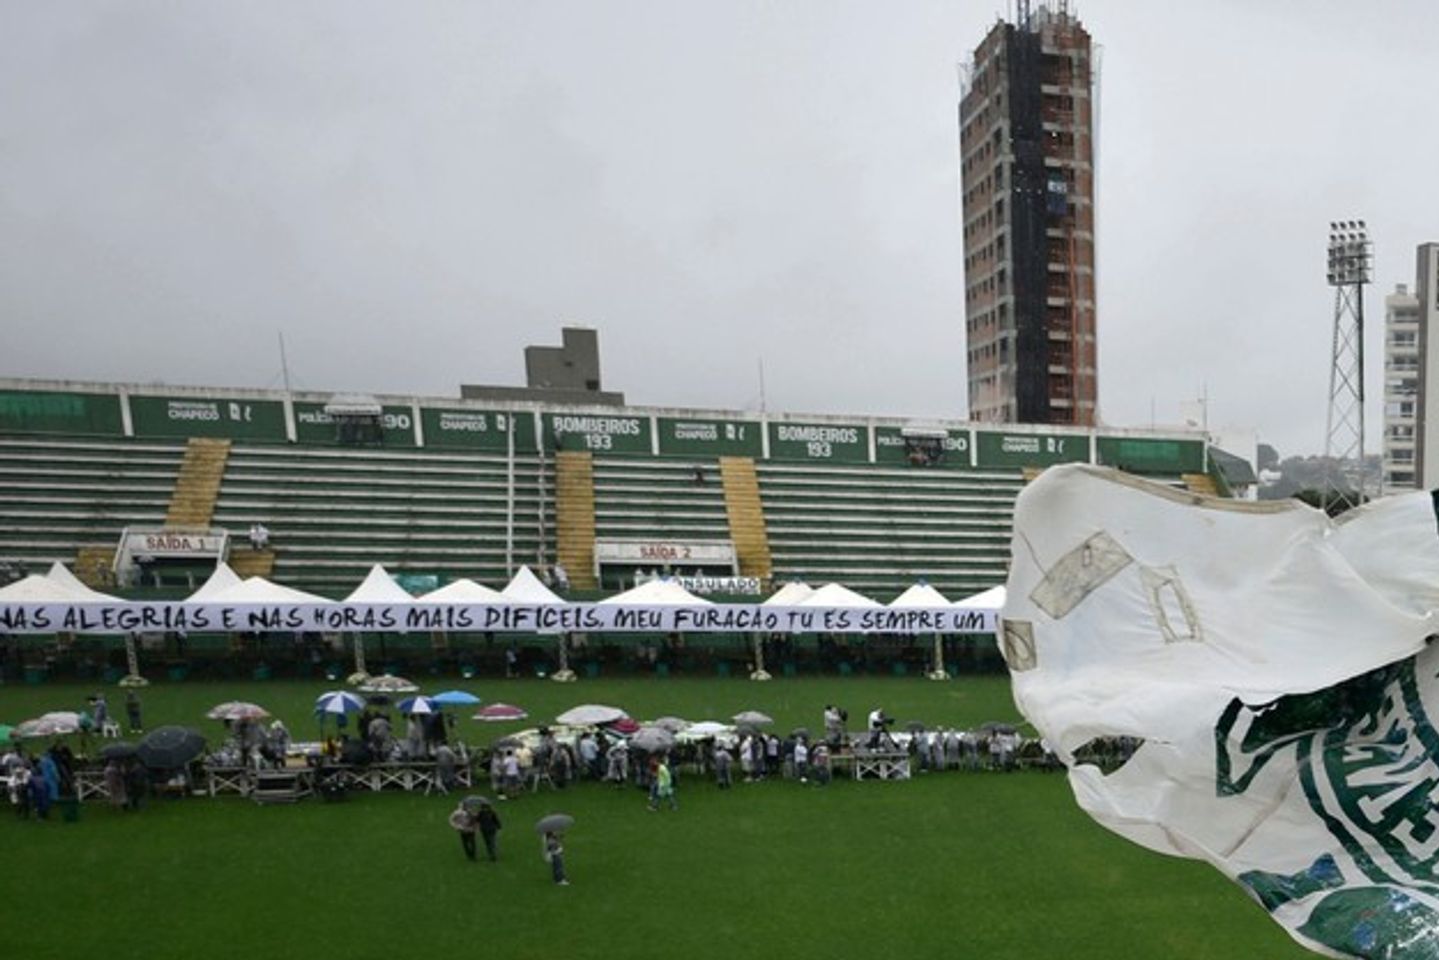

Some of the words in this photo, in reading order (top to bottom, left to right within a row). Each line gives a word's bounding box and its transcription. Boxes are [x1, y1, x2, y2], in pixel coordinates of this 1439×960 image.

[553, 416, 640, 435] BOMBEIROS
[585, 435, 612, 449] 193
[778, 426, 857, 443] BOMBEIROS
[807, 443, 832, 457] 193
[147, 534, 191, 550] SAÍDA
[199, 538, 205, 550] 1
[640, 544, 677, 559] SAÍDA
[683, 548, 691, 558] 2
[0, 606, 51, 629] NAS
[64, 606, 209, 629] ALEGRIAS
[222, 607, 235, 629] E
[249, 606, 304, 629] NAS
[314, 606, 396, 628] HORAS
[406, 606, 473, 628] MAIS
[614, 608, 662, 628] MEU
[787, 611, 813, 629] TU
[859, 610, 946, 630] SEMPRE
[953, 611, 985, 630] UM
